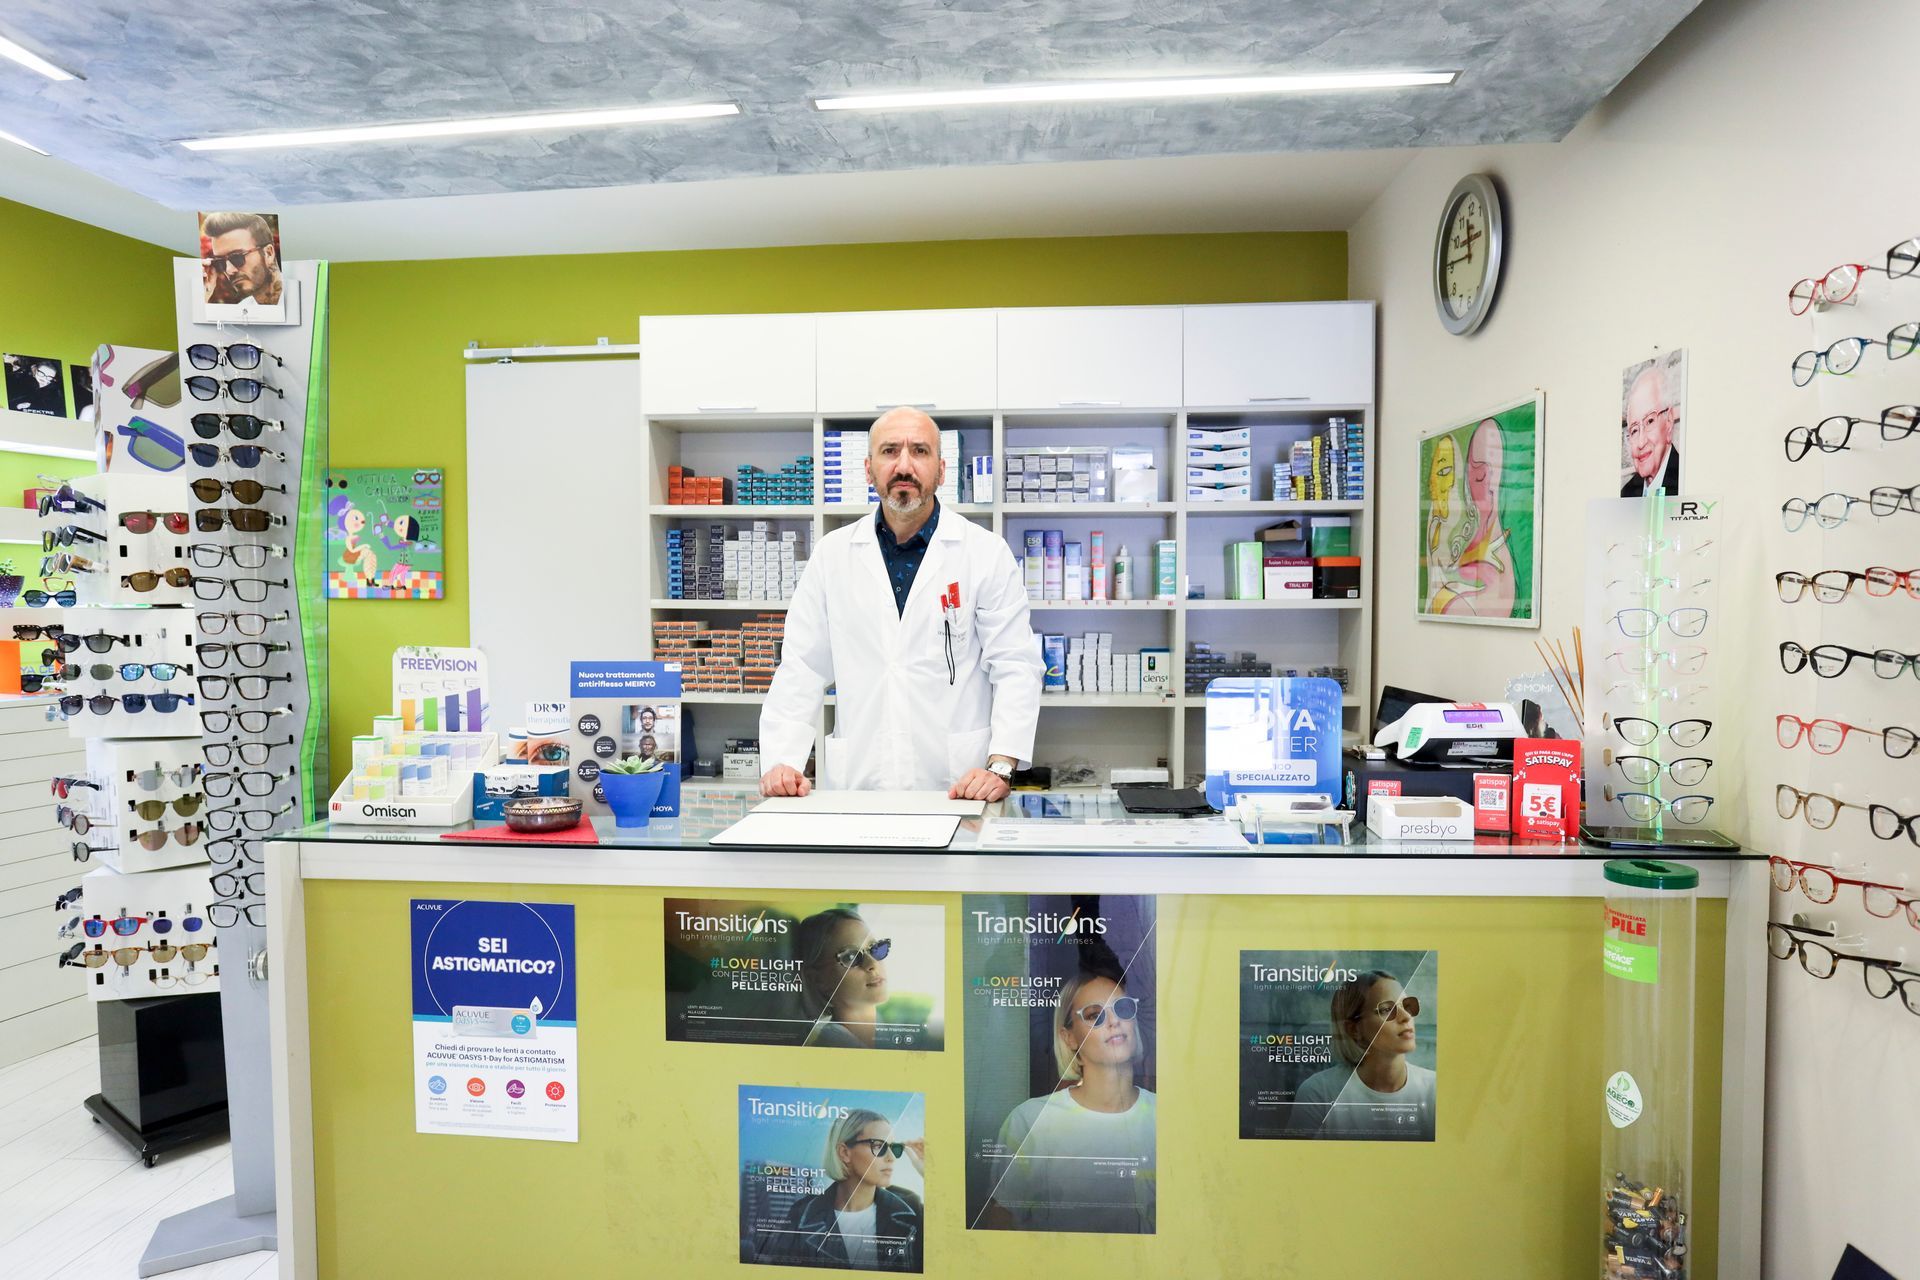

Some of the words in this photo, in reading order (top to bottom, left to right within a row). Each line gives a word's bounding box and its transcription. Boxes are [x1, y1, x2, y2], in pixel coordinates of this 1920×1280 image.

[1468, 202, 1474, 216] 12
[1458, 216, 1465, 230] 11
[1454, 236, 1460, 250] 10
[1452, 282, 1456, 296] 8
[1458, 294, 1464, 309] 7
[400, 658, 478, 672] FREEVISION
[534, 704, 566, 712] DROP
[1525, 756, 1573, 768] SATISPAY
[1236, 774, 1310, 782] SPECIALIZZATO
[1479, 779, 1506, 787] satispay
[1530, 796, 1556, 812] 5€
[362, 804, 416, 818] Omisan
[1400, 819, 1458, 838] presbyo
[676, 911, 788, 934] Transitions
[972, 911, 1107, 934] Transitions
[1612, 916, 1646, 936] PILE
[680, 933, 699, 942] light
[702, 934, 744, 942] intelligent
[978, 937, 1000, 946] light
[1004, 937, 1054, 946] intelligent
[478, 937, 508, 954] SEI
[432, 956, 556, 974] ASTIGMATICO?
[710, 958, 803, 970] #LOVELIGHT
[732, 971, 802, 983] FEDERICA
[1250, 964, 1357, 982] Transitions
[732, 982, 802, 992] PELLEGRINI
[993, 989, 1061, 998] FEDERICA
[993, 999, 1061, 1007] PELLEGRINI
[456, 1010, 490, 1018] ACUVUE
[1250, 1035, 1332, 1045] #LOVELIGHT
[1269, 1046, 1331, 1055] FEDERICA
[1607, 1087, 1635, 1108] AGECO
[748, 1098, 849, 1119] Transitions
[750, 1165, 826, 1177] #LOVELIGHT
[767, 1177, 824, 1187] FEDERICA
[767, 1185, 824, 1194] PELLEGRINI
